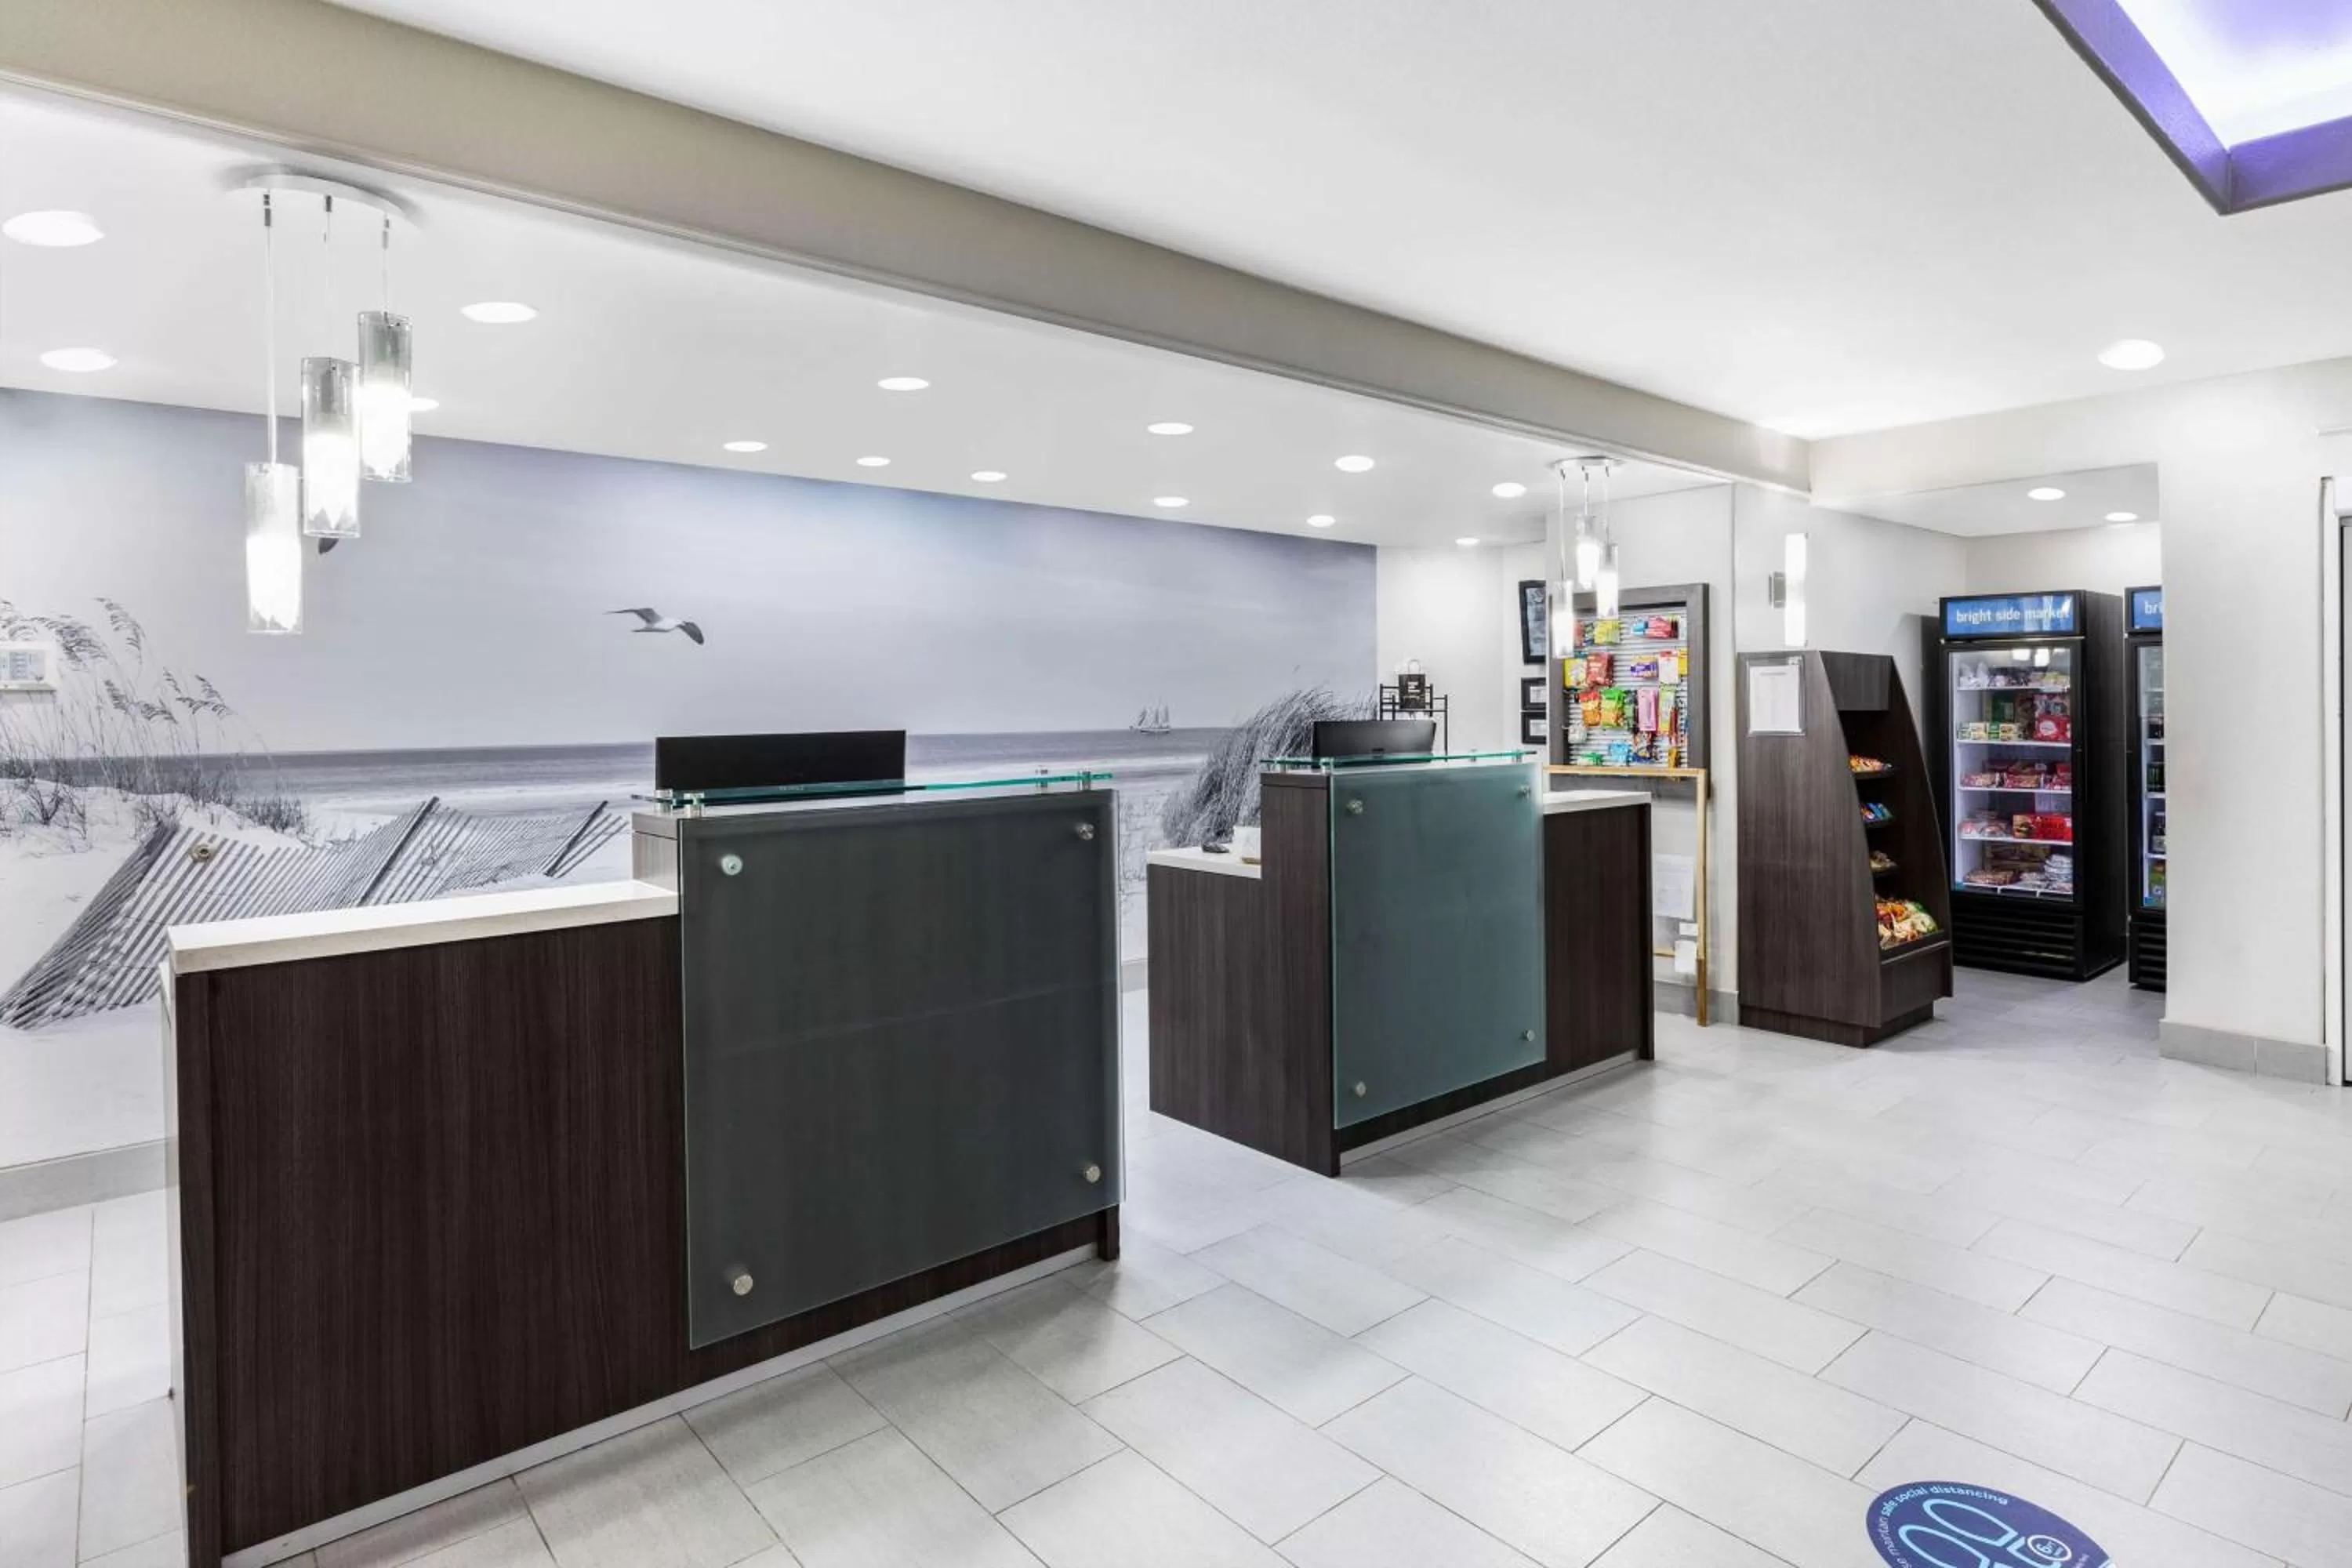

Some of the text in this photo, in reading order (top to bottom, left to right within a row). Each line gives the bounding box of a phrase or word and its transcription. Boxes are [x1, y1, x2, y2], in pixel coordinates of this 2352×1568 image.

[1956, 608, 1991, 624] bright
[1996, 607, 2020, 621] side
[1881, 1499, 1898, 1517] safe
[1894, 1486, 1929, 1503] social
[1929, 1486, 2008, 1505] distancing
